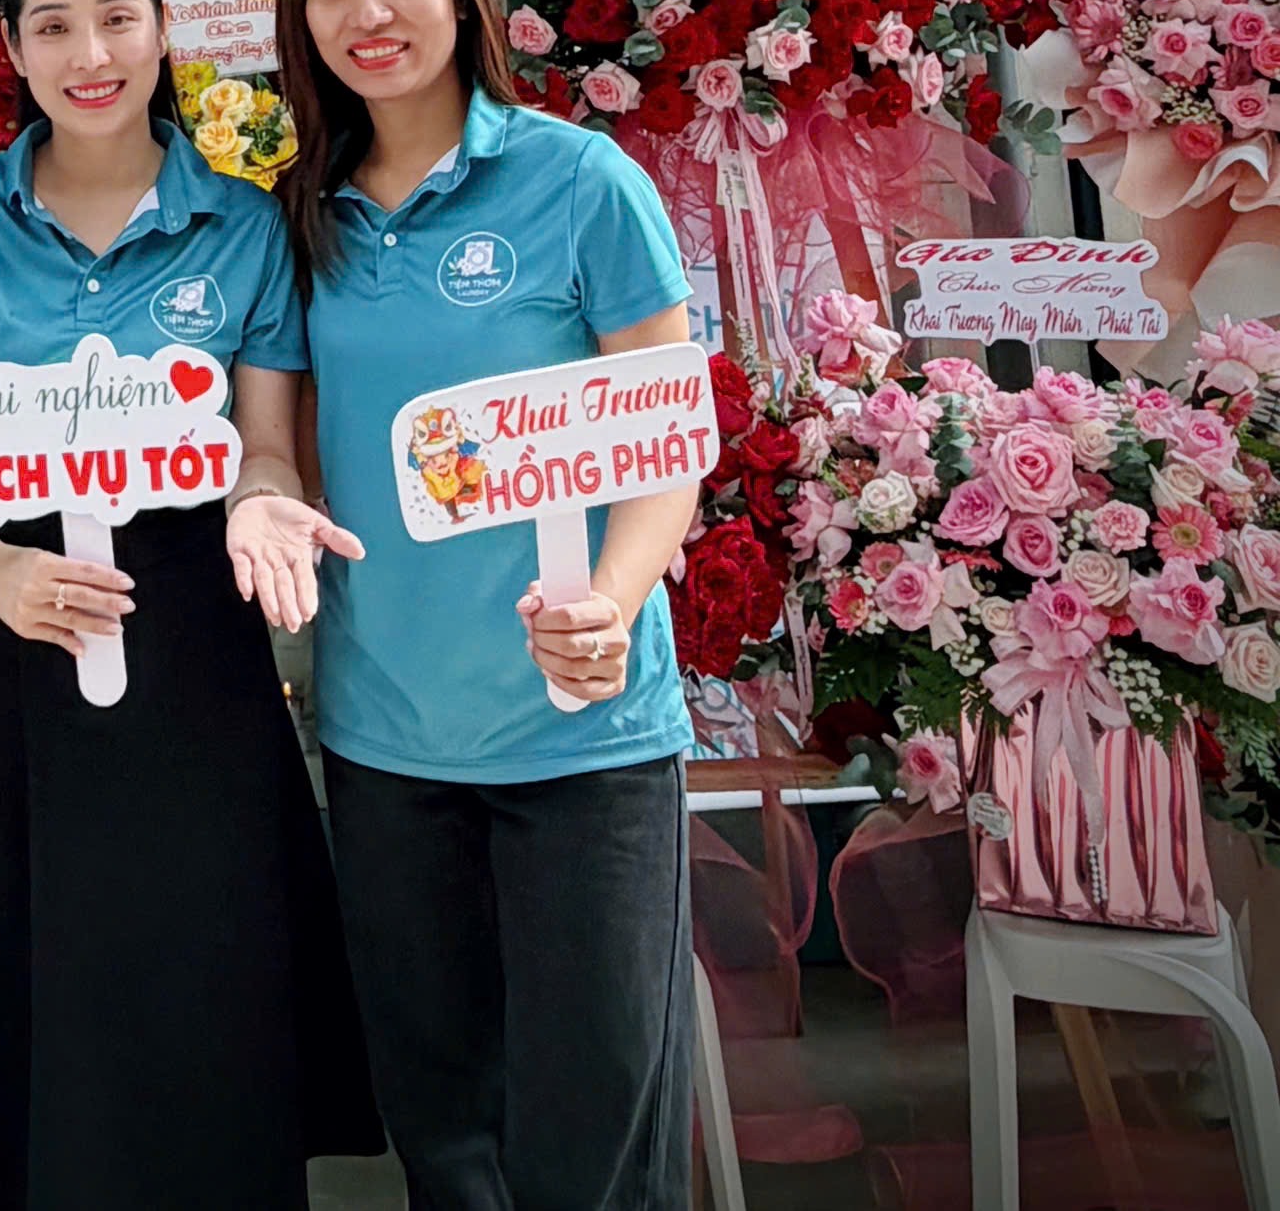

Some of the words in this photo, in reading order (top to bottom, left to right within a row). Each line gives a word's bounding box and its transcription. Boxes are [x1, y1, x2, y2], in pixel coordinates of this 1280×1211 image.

[908, 303, 942, 331] Khai
[999, 301, 1037, 342] May
[1095, 305, 1133, 335] Phát
[35, 352, 175, 445] nghiệm
[482, 392, 571, 444] Khai
[581, 374, 706, 423] Trương
[62, 449, 127, 507] VỤ
[142, 428, 229, 491] TỐT
[483, 444, 602, 515] HỒNG
[611, 422, 710, 487] PHÁT
